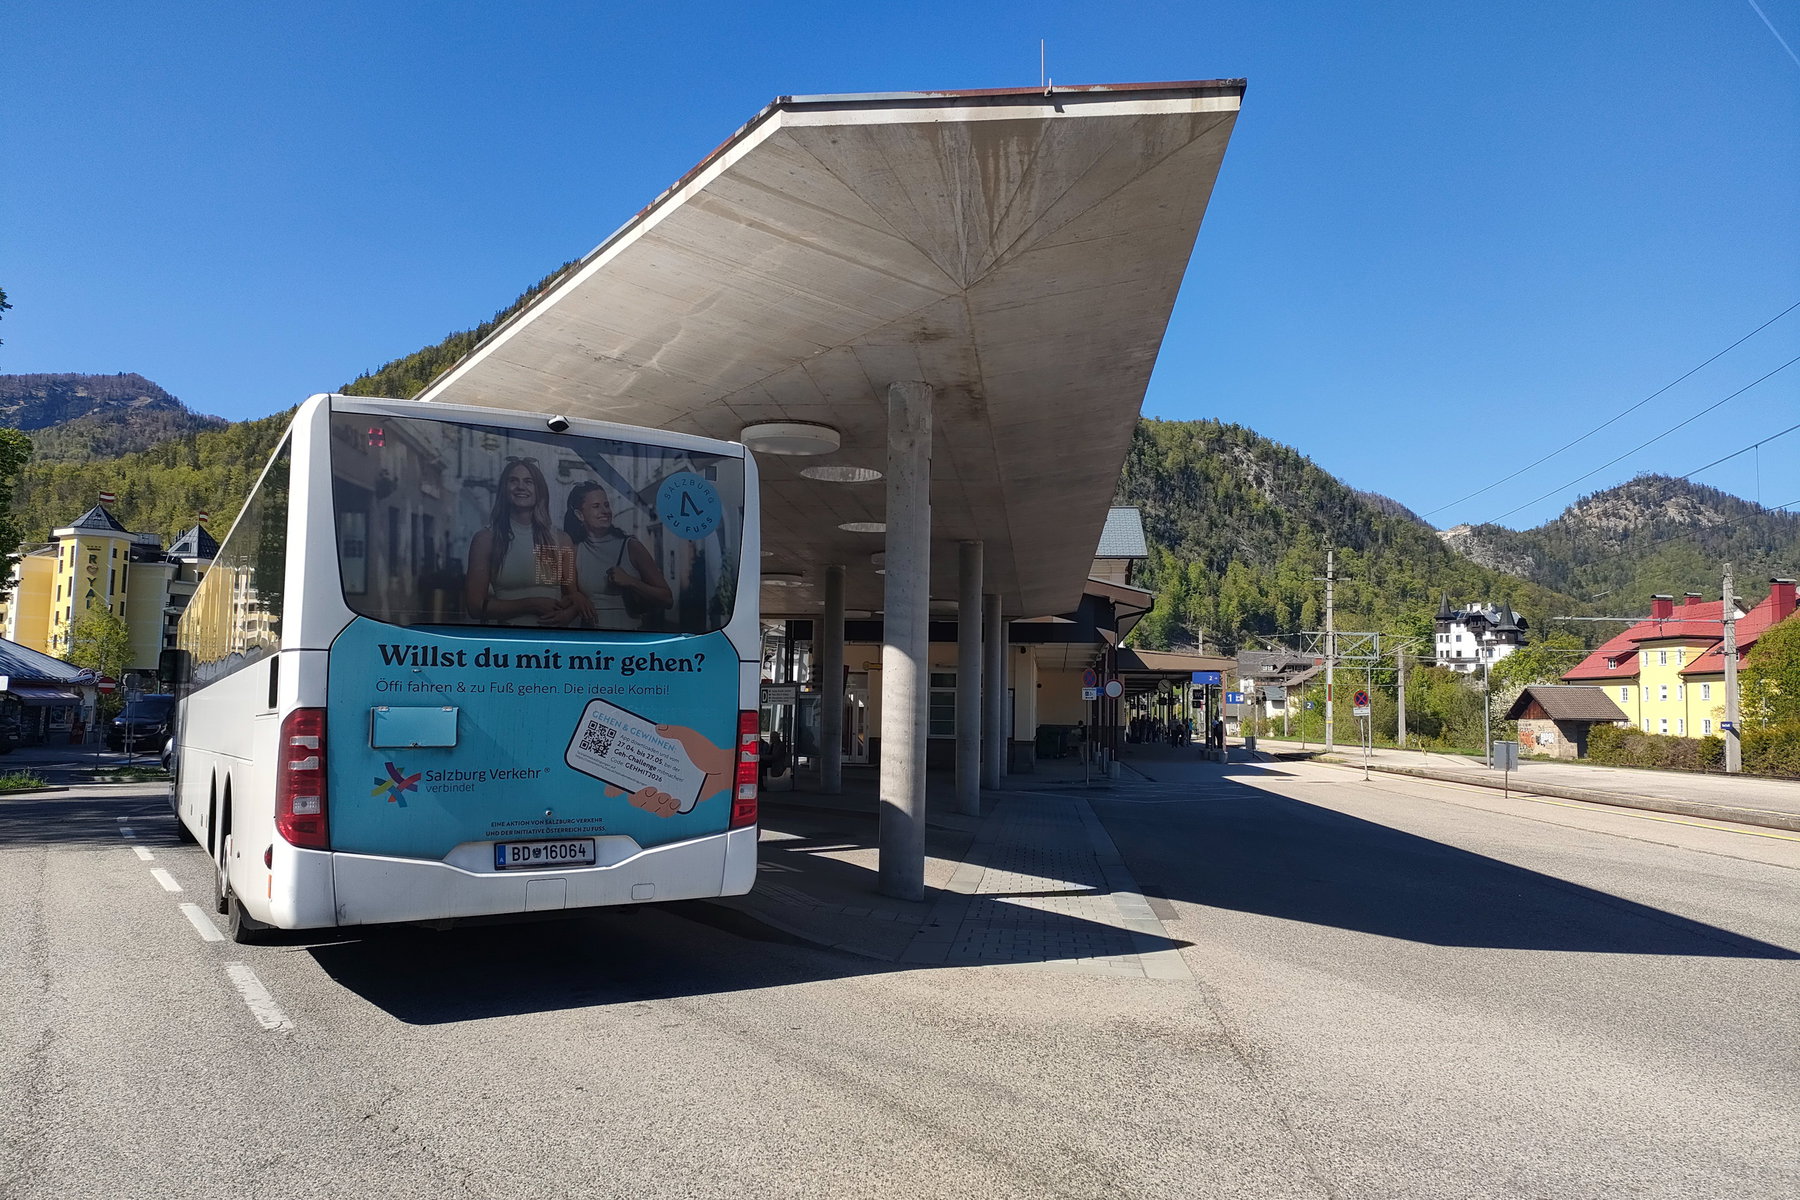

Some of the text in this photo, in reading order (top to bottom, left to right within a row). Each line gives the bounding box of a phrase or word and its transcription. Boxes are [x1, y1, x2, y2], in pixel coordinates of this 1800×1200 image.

[664, 479, 714, 504] SALZBURG
[667, 513, 713, 533] ZU FUSS
[532, 544, 574, 585] 150
[378, 644, 705, 677] Willst du mit mir gehen?
[376, 678, 670, 697] Öffi fahren & zu Fuß gehen. Die ideale Kombi!
[1227, 694, 1232, 702] 1
[592, 710, 677, 754] GEHEN & GEWINNEN:
[617, 740, 636, 754] 27.04.
[636, 749, 647, 758] bis
[646, 752, 664, 766] 27.05.
[663, 761, 672, 769] bei
[620, 734, 631, 743] App
[631, 739, 660, 755] downloaden
[659, 751, 670, 760] und
[613, 749, 658, 772] Geh-Challenge
[426, 769, 487, 782] Salzburg
[489, 767, 541, 780] Verkehr
[624, 761, 664, 783] GEHMIT2026
[426, 783, 475, 793] verbindet
[545, 825, 582, 834] ÖSTERREICH
[511, 843, 586, 862] BD 16064
